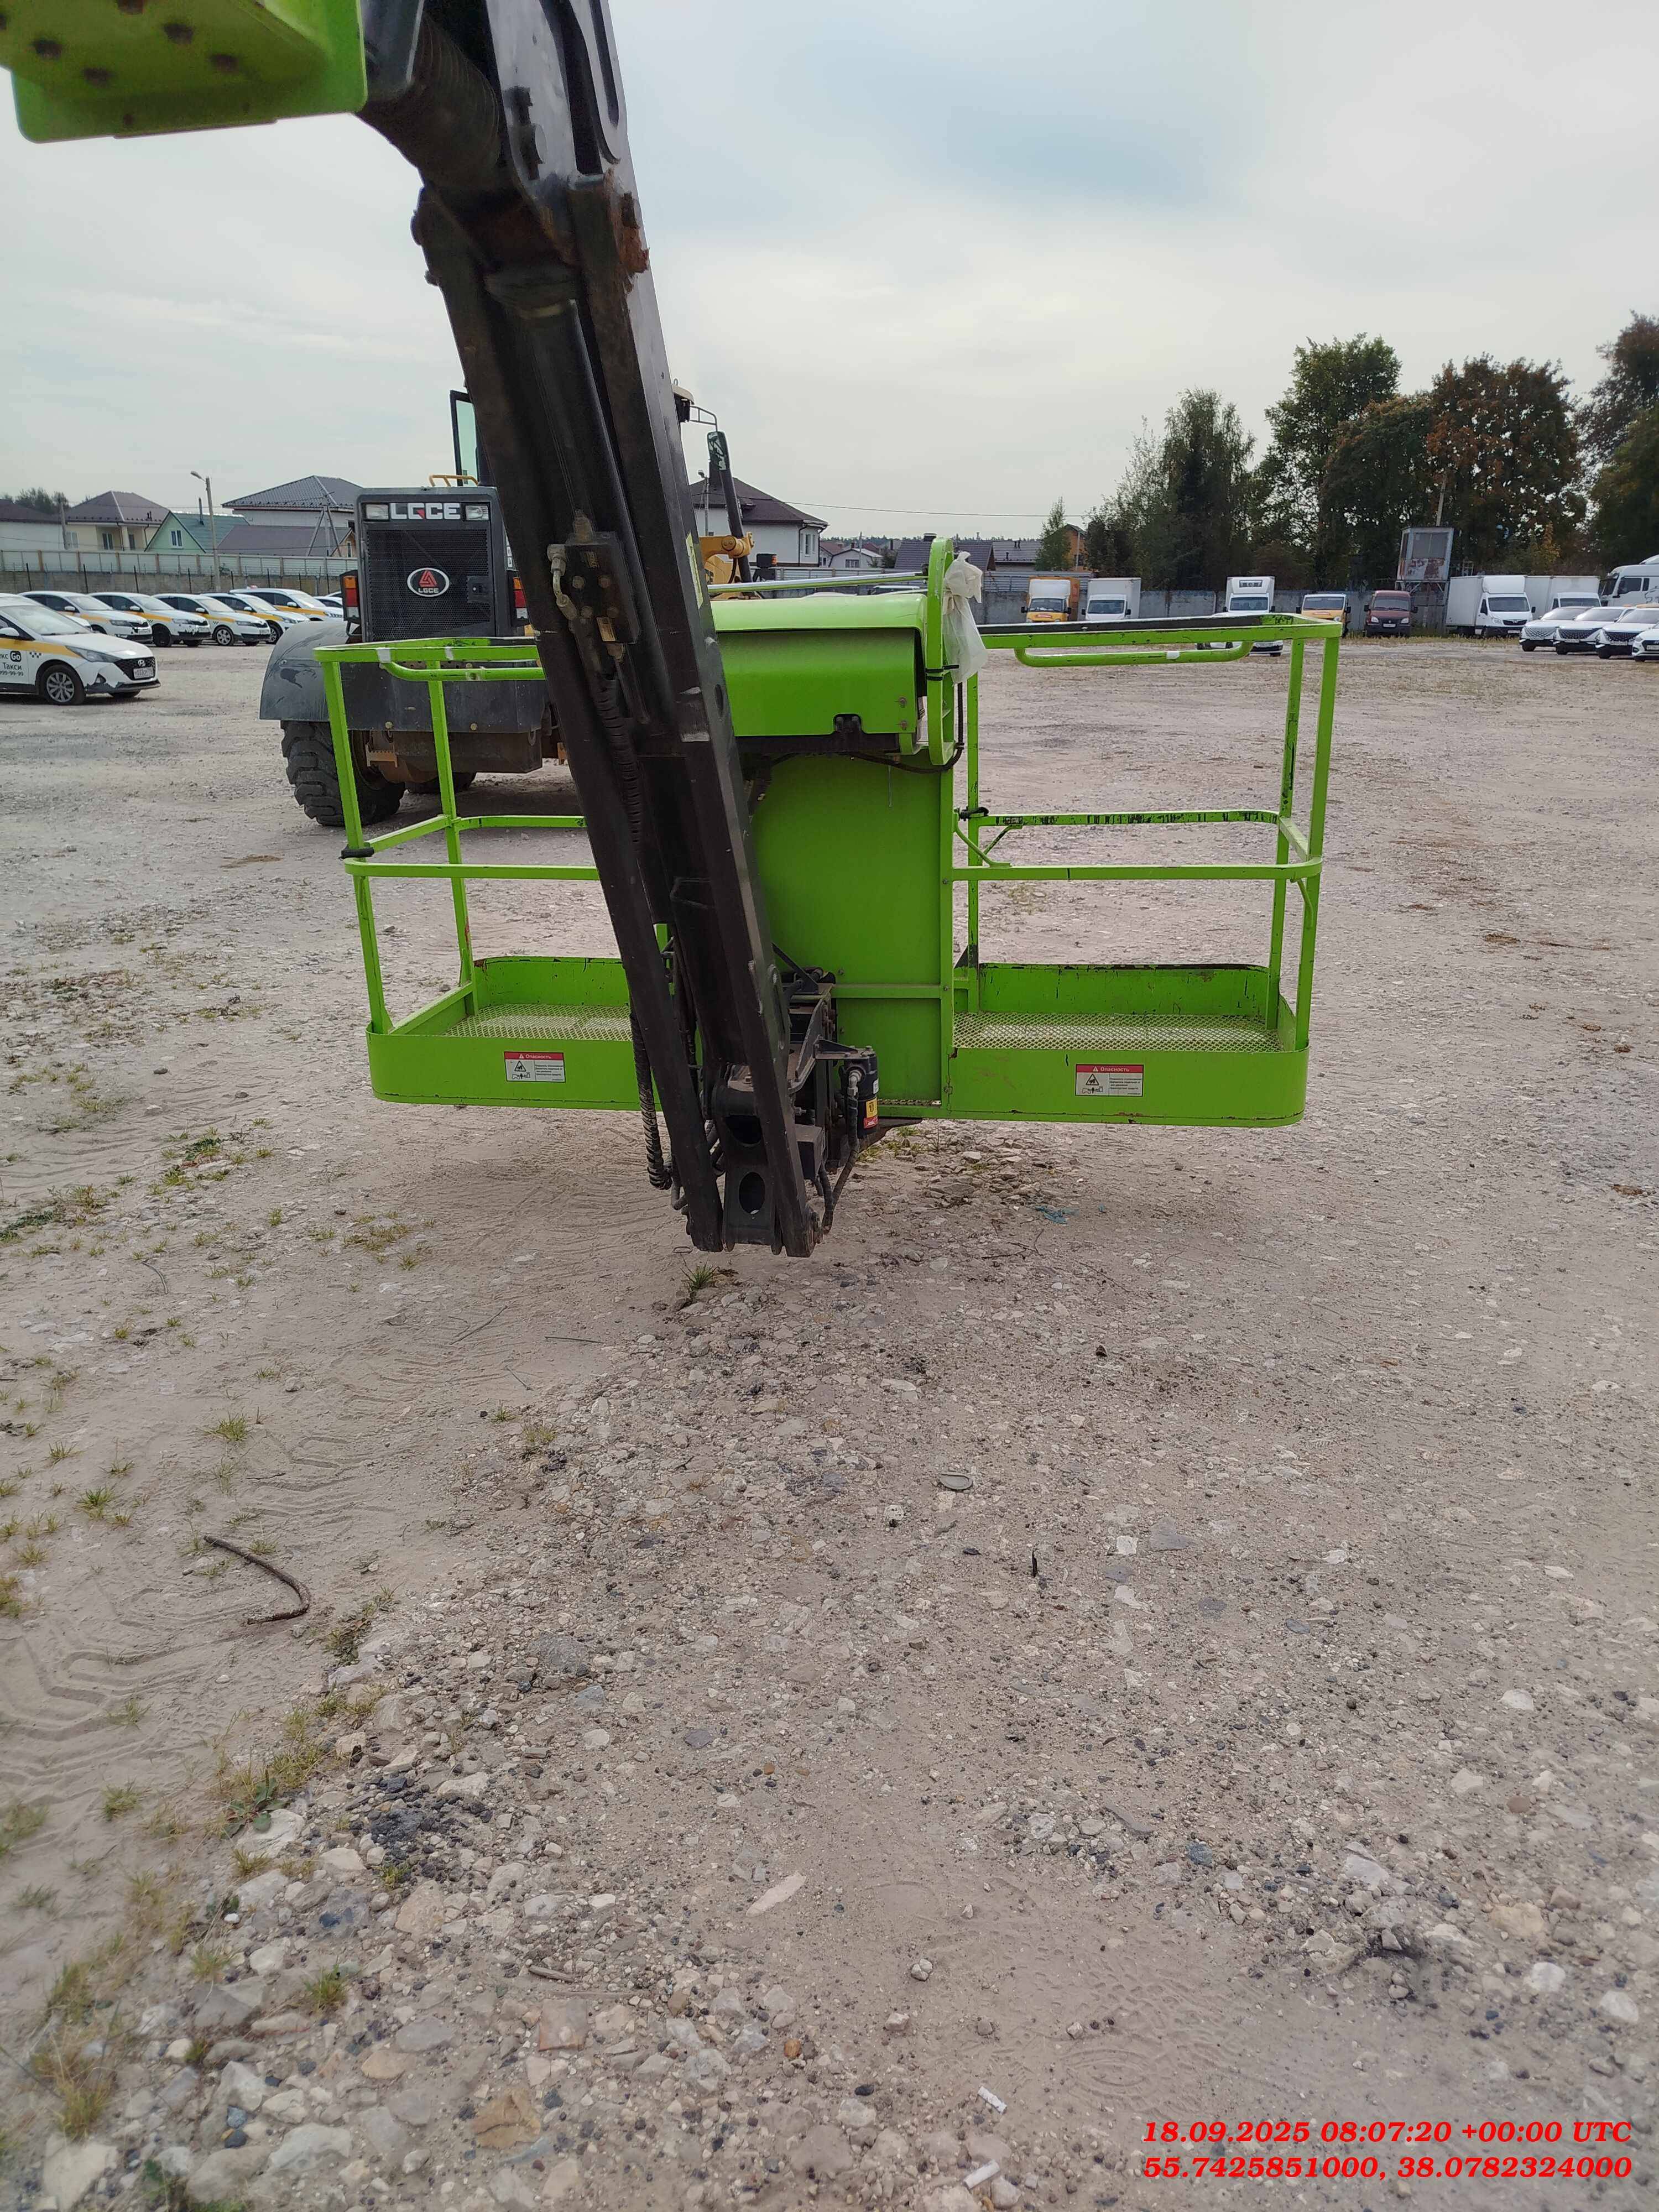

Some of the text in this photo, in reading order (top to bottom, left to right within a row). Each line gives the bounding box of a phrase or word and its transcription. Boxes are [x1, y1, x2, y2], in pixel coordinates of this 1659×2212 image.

[390, 502, 461, 520] LGCE
[11, 652, 21, 660] Go
[3, 662, 22, 670] Такси
